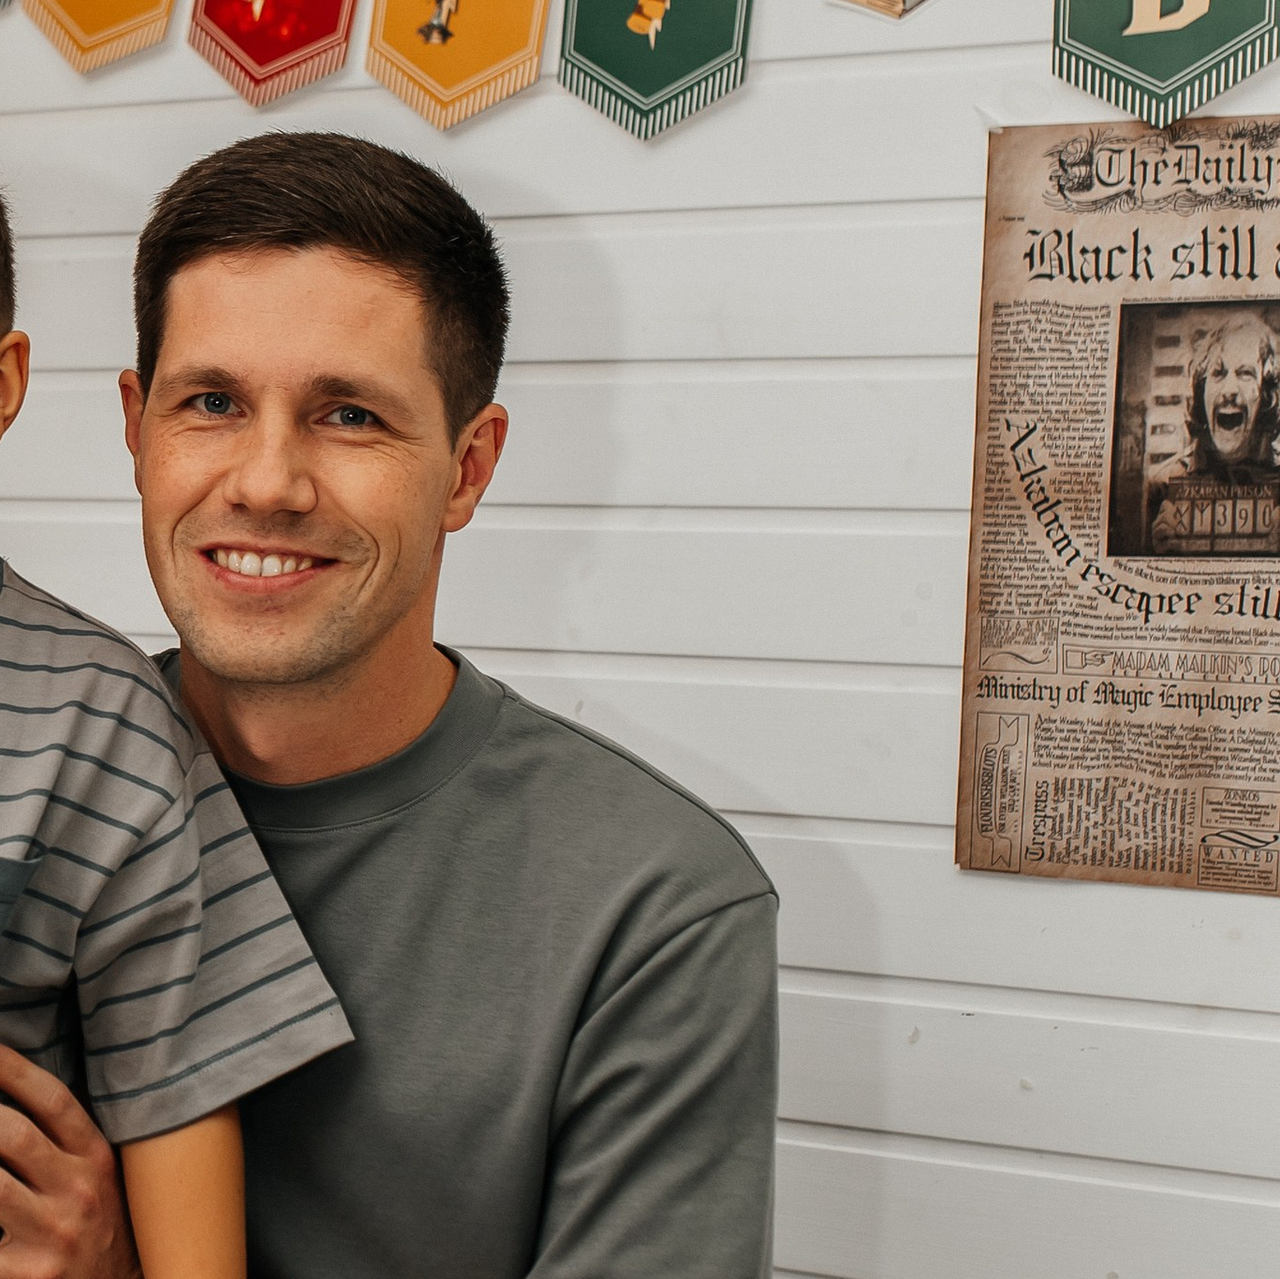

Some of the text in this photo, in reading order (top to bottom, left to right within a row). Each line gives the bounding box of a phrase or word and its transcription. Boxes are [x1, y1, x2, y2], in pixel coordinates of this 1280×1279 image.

[1094, 142, 1273, 205] The Daily
[1023, 228, 1155, 284] Black
[1170, 224, 1260, 282] still
[1080, 564, 1203, 624] escapee
[1170, 576, 1177, 585] of
[1112, 651, 1170, 671] MADAM
[975, 674, 1061, 709] Ministry
[1065, 680, 1089, 704] of
[1093, 682, 1154, 713] Magic
[1159, 683, 1263, 719] Employee
[1025, 780, 1053, 862] Trespass
[1203, 846, 1273, 864] WANTED
